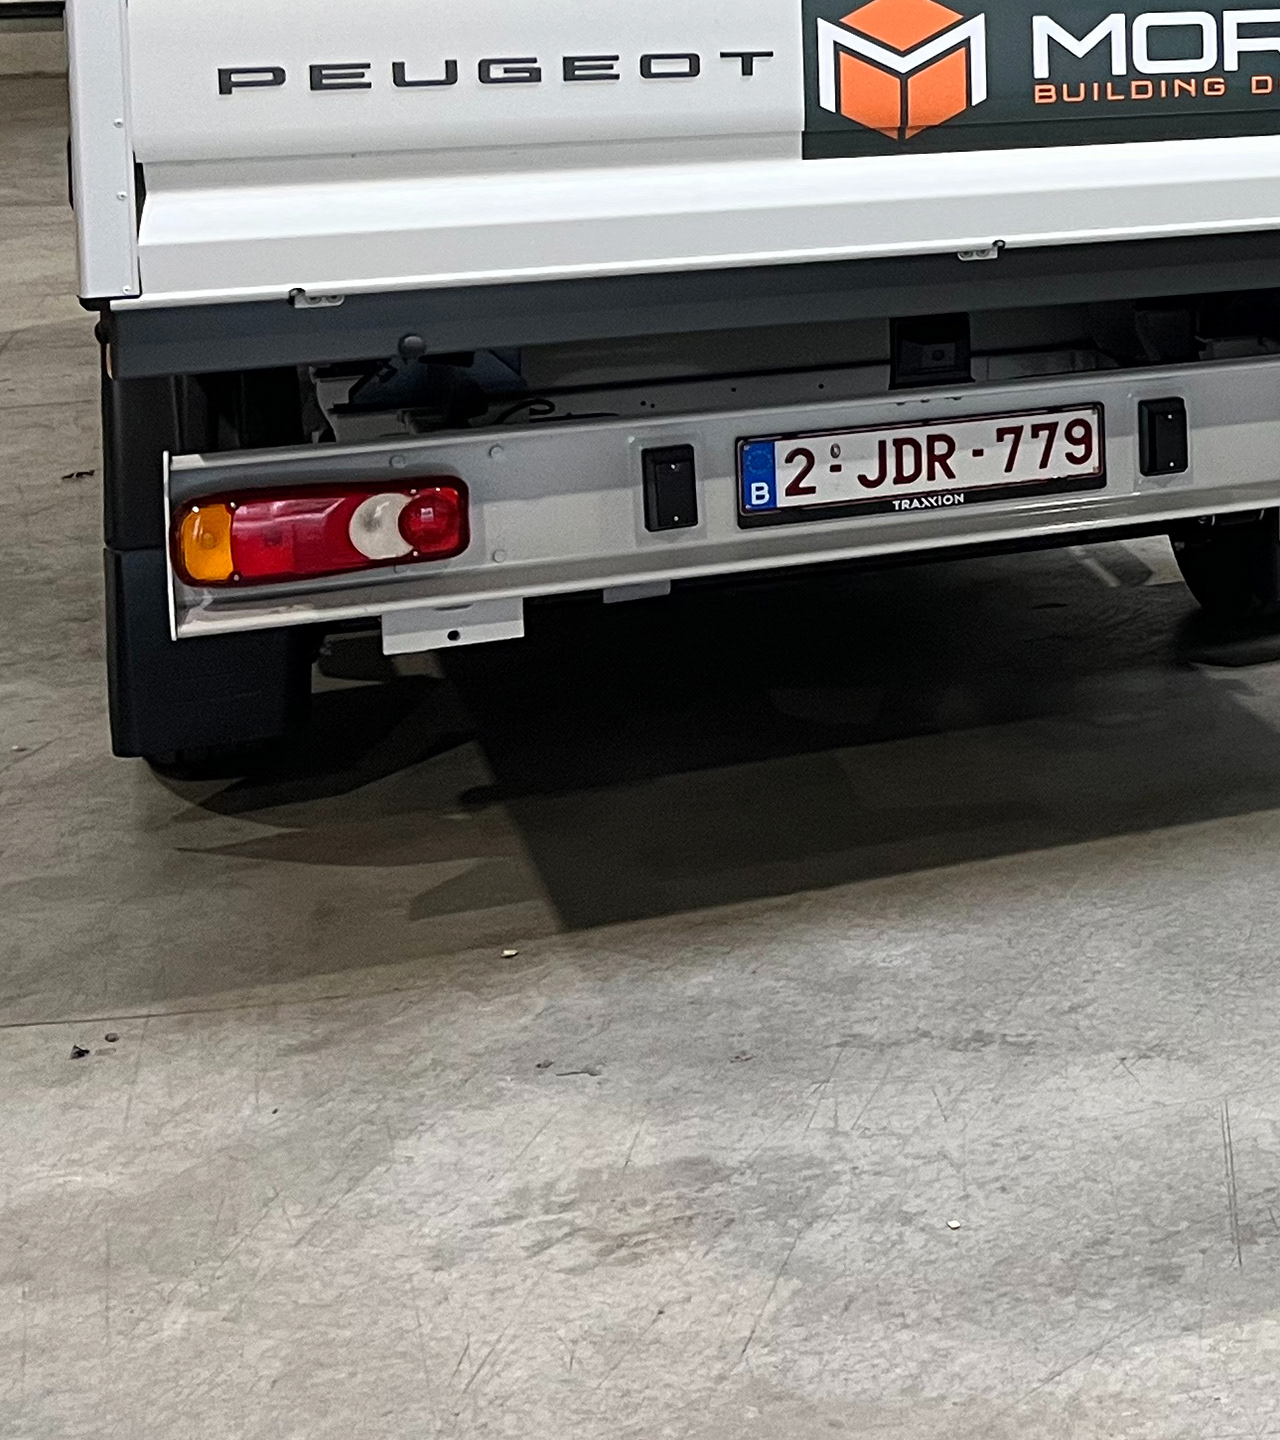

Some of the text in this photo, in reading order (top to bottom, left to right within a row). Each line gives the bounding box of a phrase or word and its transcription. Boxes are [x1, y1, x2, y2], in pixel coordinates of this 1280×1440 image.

[217, 50, 774, 95] PEUGEOT
[1033, 76, 1226, 105] BUILDING
[750, 482, 770, 506] B
[892, 493, 965, 512] TRAXXION
